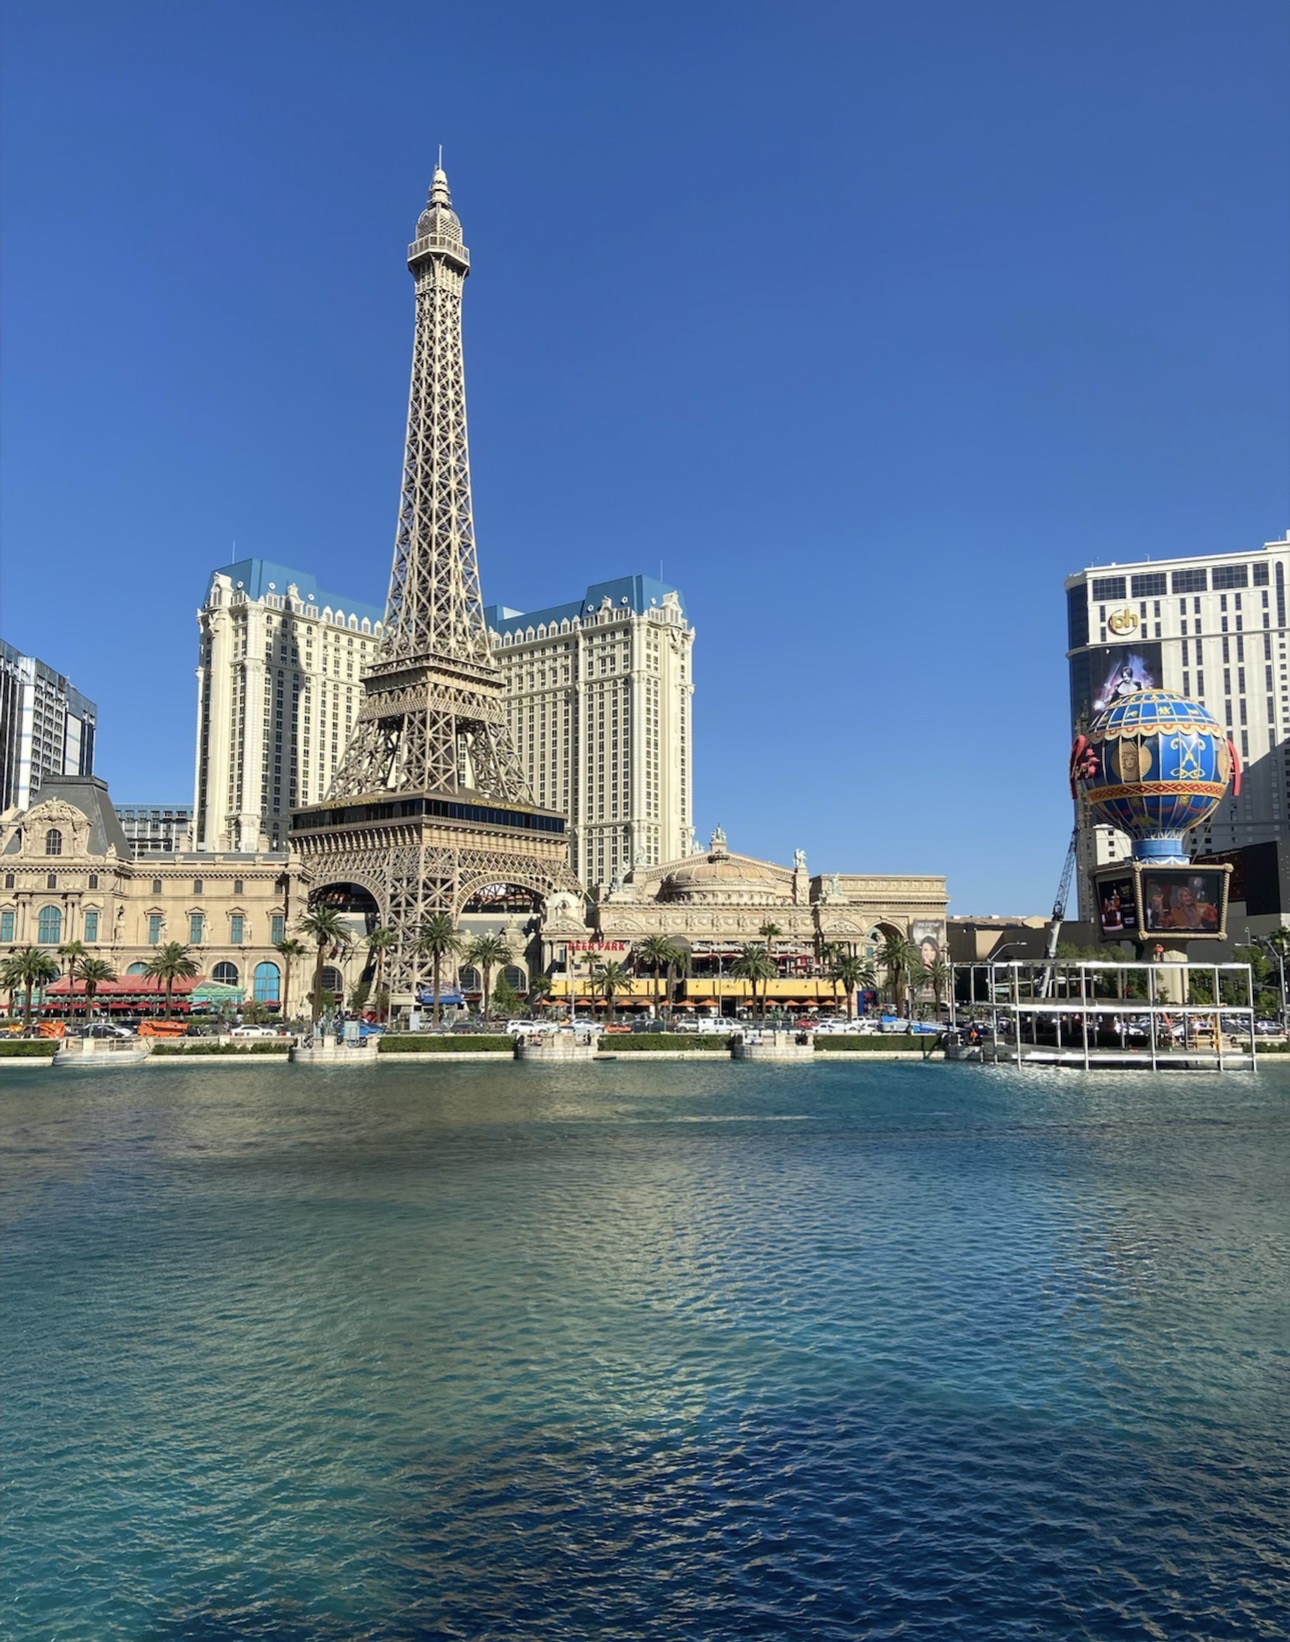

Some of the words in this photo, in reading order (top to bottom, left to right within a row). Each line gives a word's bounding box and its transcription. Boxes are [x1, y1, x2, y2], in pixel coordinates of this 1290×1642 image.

[1111, 608, 1139, 631] ph
[567, 941, 595, 951] BEER
[598, 941, 625, 951] PARK
